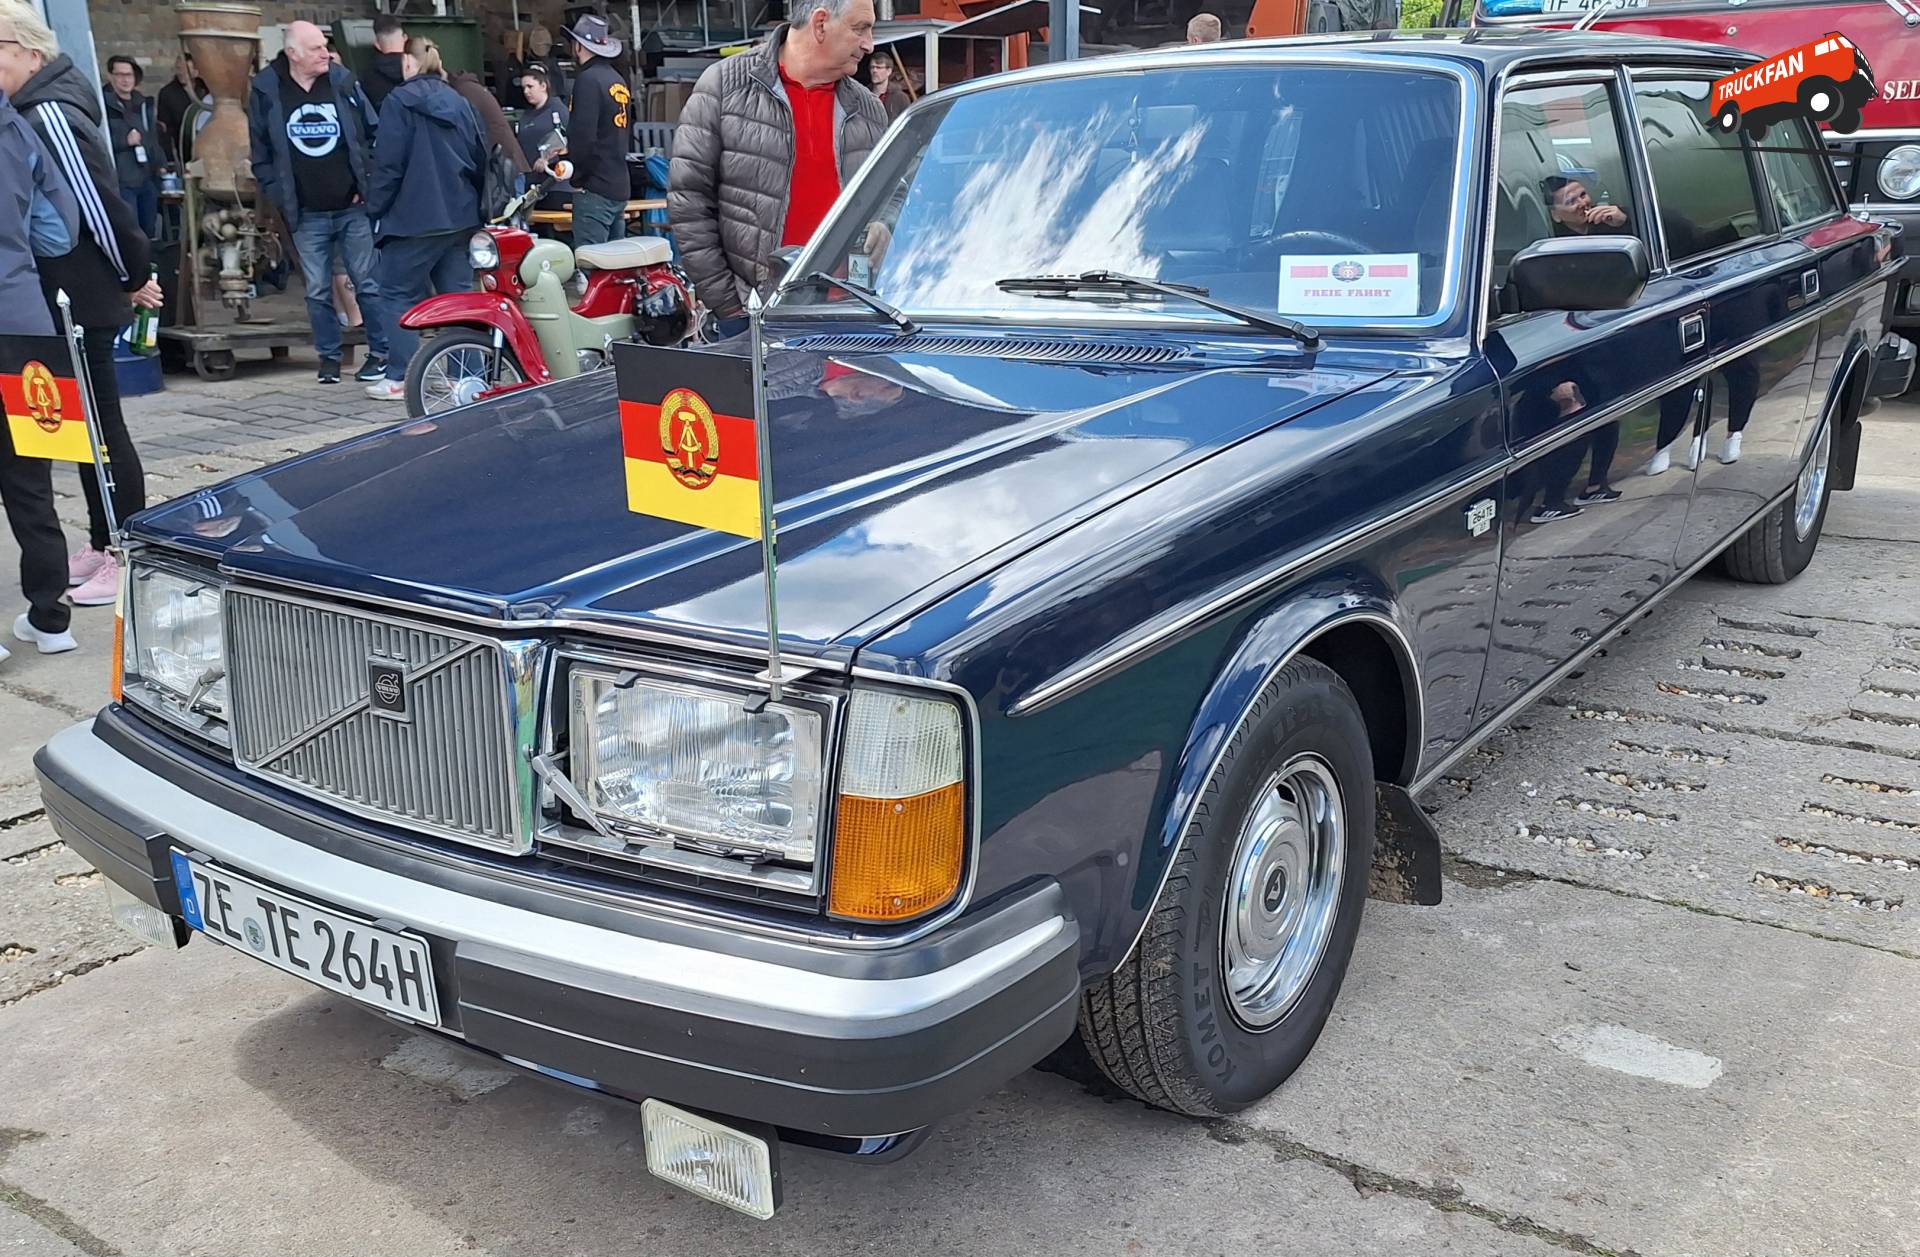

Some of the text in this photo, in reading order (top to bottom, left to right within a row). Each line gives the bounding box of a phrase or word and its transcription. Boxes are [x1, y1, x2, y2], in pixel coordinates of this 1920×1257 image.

[290, 124, 337, 135] VOLVO
[1303, 289, 1392, 298] FREIE FAHRT
[186, 897, 195, 915] D
[193, 871, 242, 941] ZE
[256, 896, 310, 970] TE
[313, 919, 428, 1012] 264H
[1193, 962, 1237, 1084] KOMET
